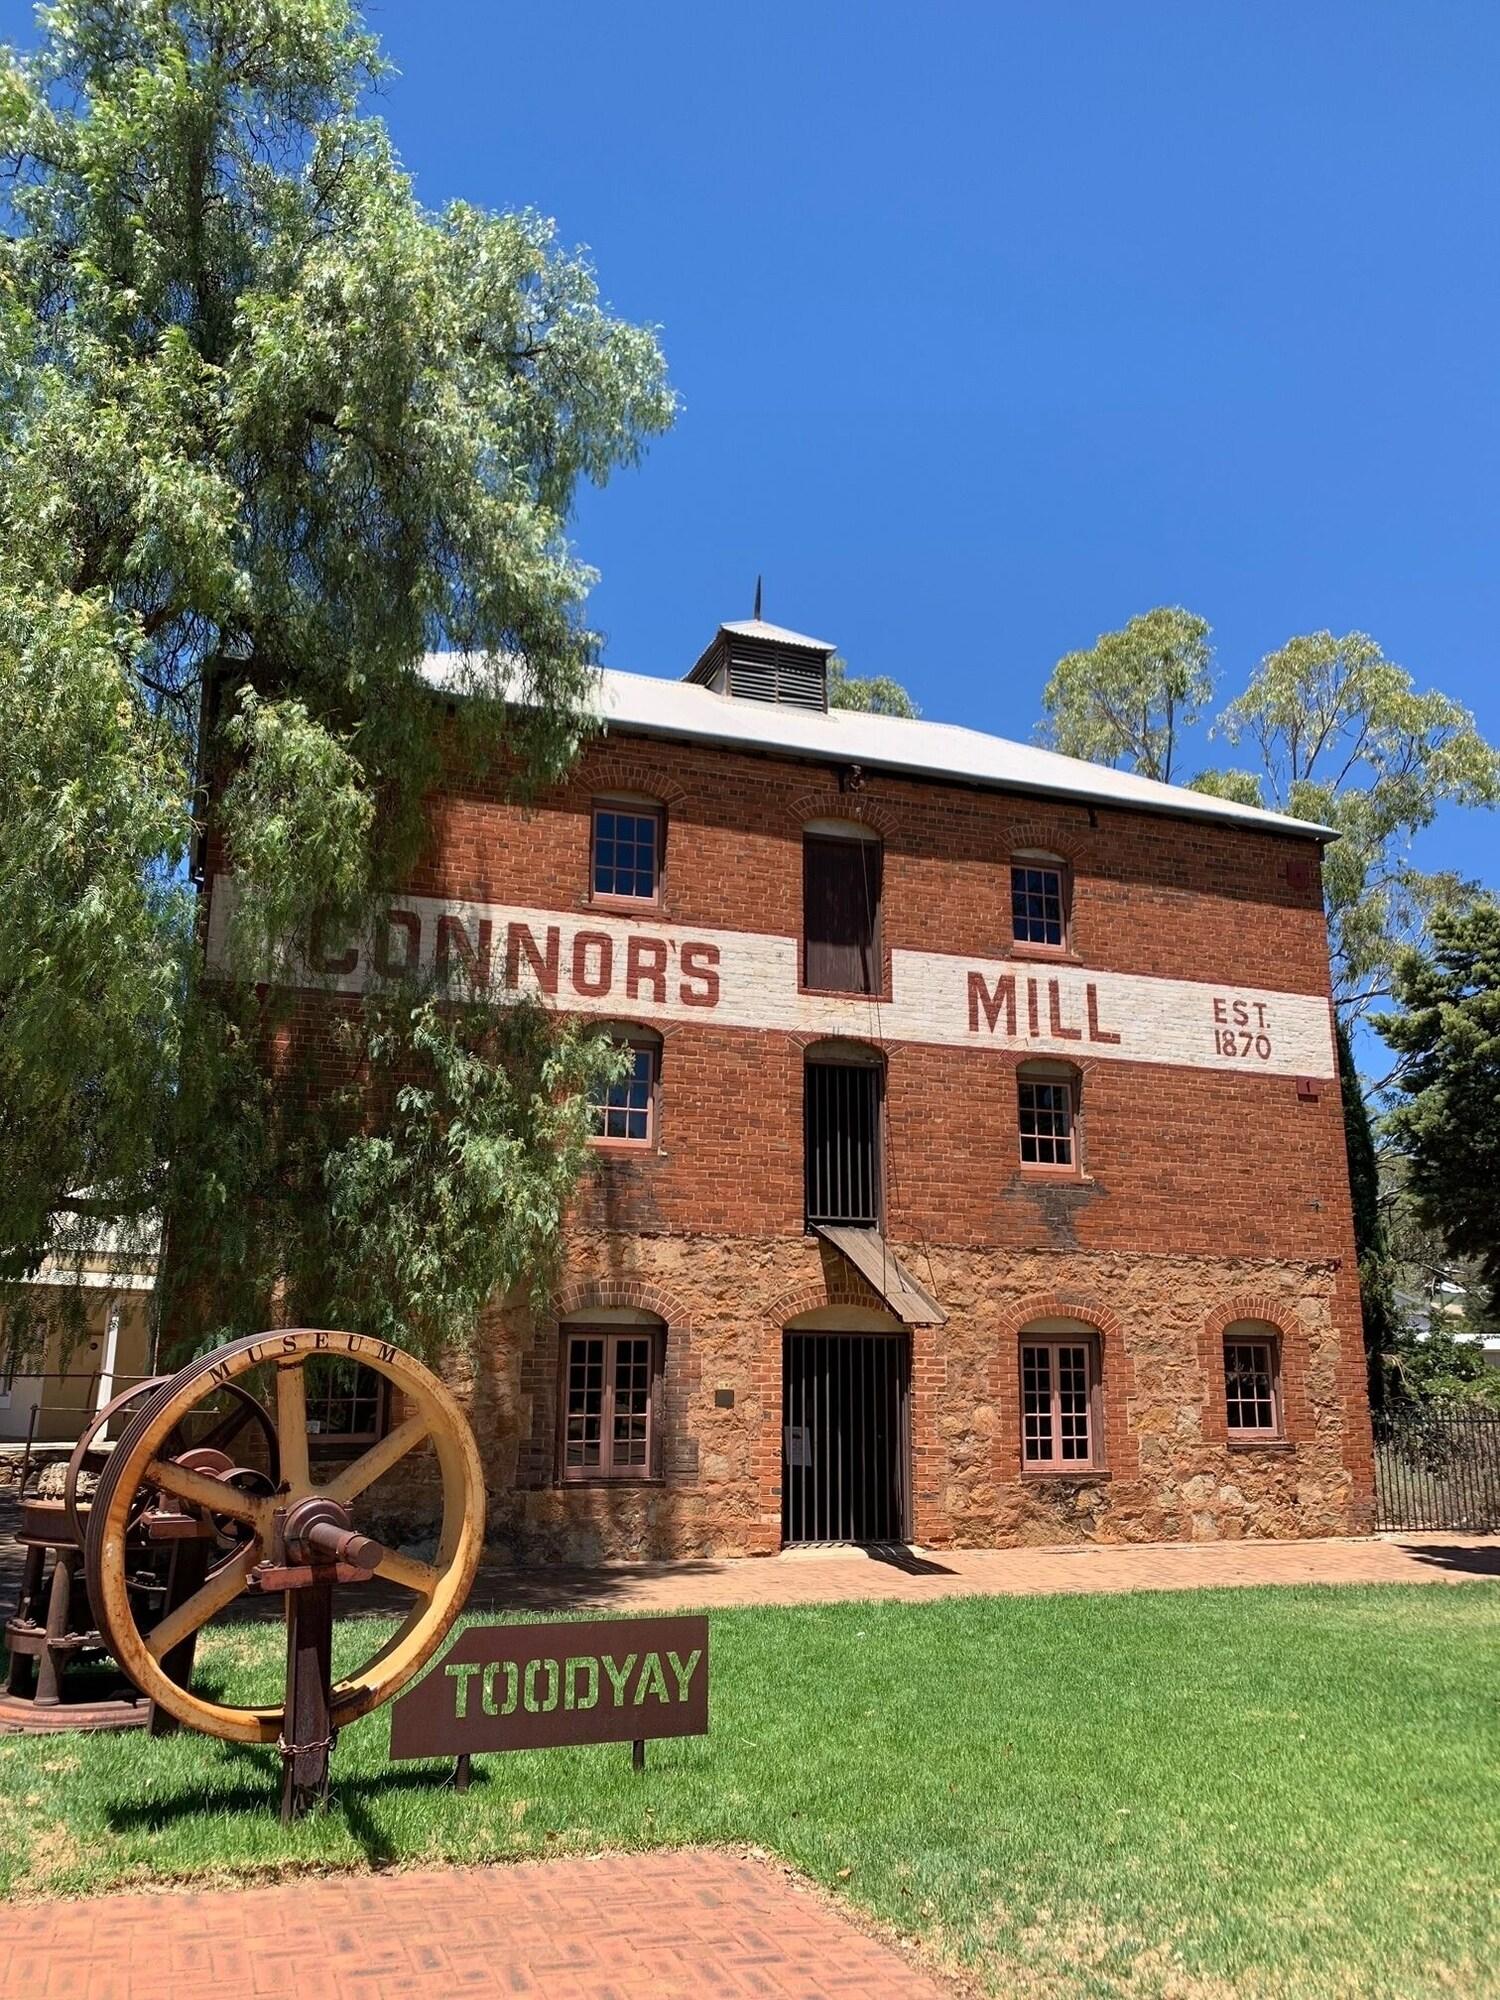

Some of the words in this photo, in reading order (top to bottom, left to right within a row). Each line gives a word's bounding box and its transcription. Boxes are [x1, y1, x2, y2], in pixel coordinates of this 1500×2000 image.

[309, 903, 721, 1008] CONNOR'S
[967, 971, 1121, 1045] MILL
[1213, 997, 1271, 1029] EST.
[1214, 1029, 1272, 1061] 1870
[208, 1332, 398, 1385] MUSEUM
[445, 1650, 702, 1718] TOODYAY
